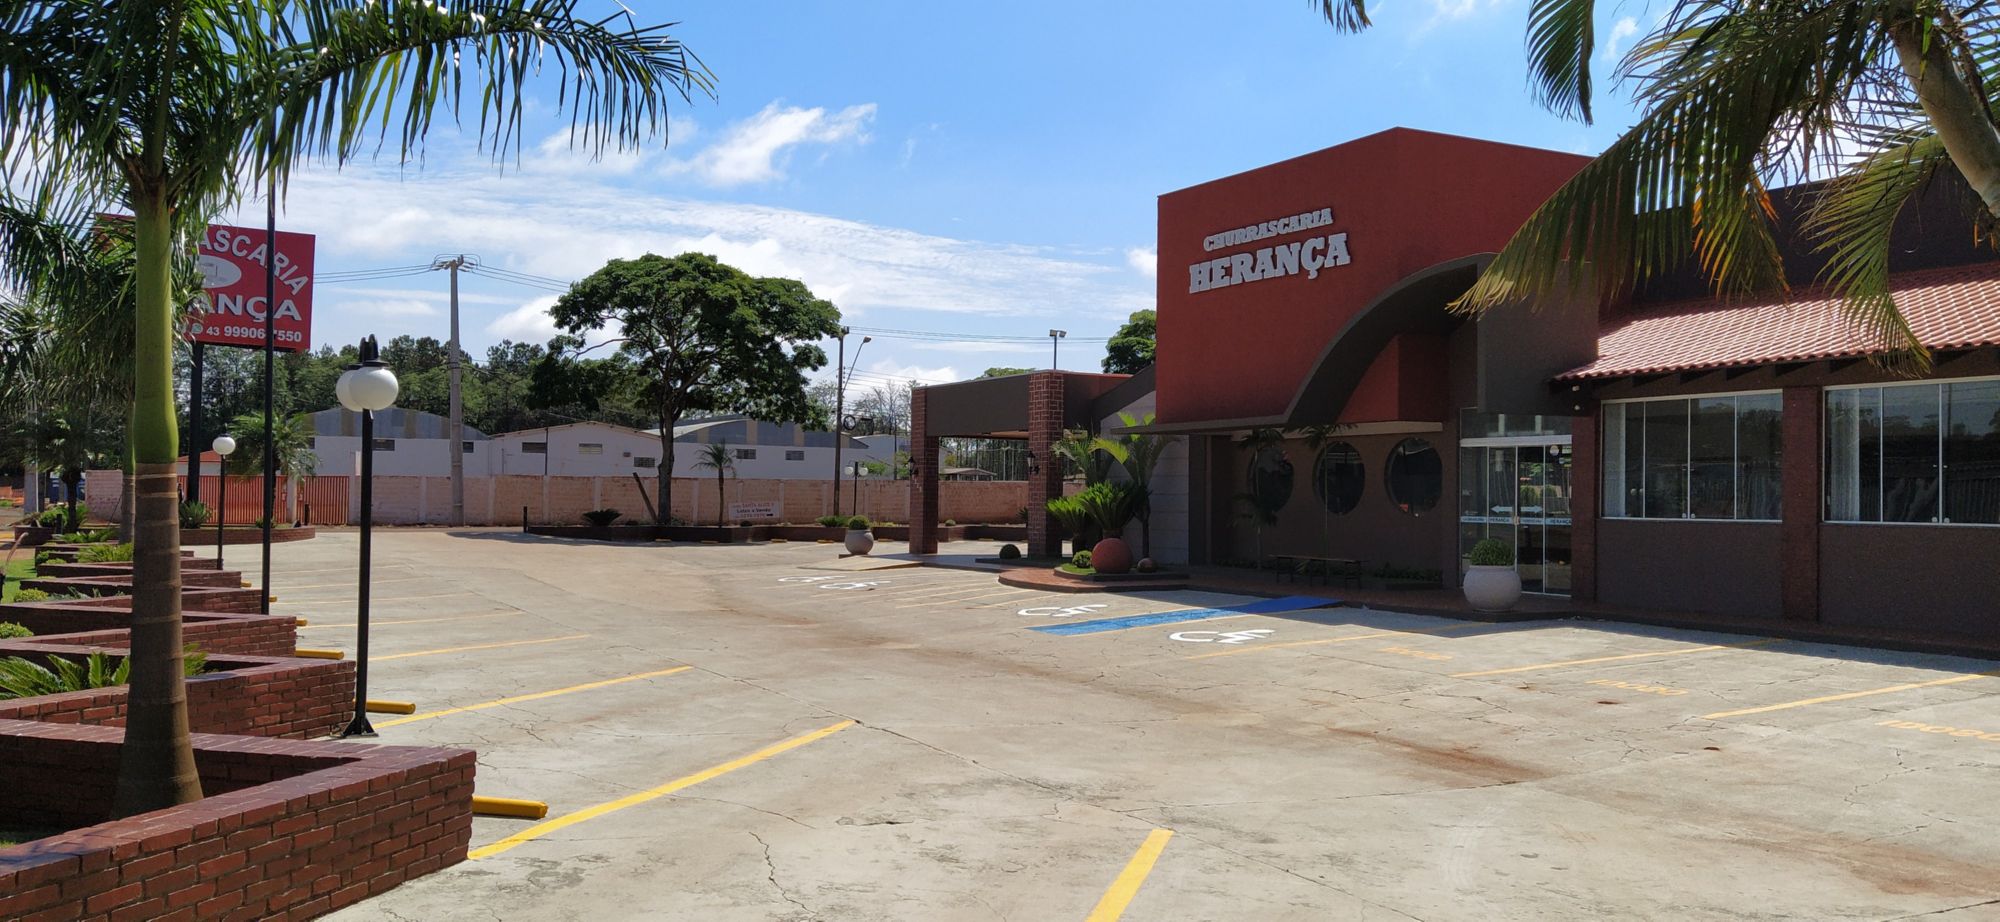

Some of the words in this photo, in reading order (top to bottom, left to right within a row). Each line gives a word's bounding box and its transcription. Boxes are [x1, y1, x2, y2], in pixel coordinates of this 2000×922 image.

[1203, 207, 1334, 252] CHURRASCARIA
[1189, 232, 1351, 294] HERANÇA
[206, 326, 220, 337] 43
